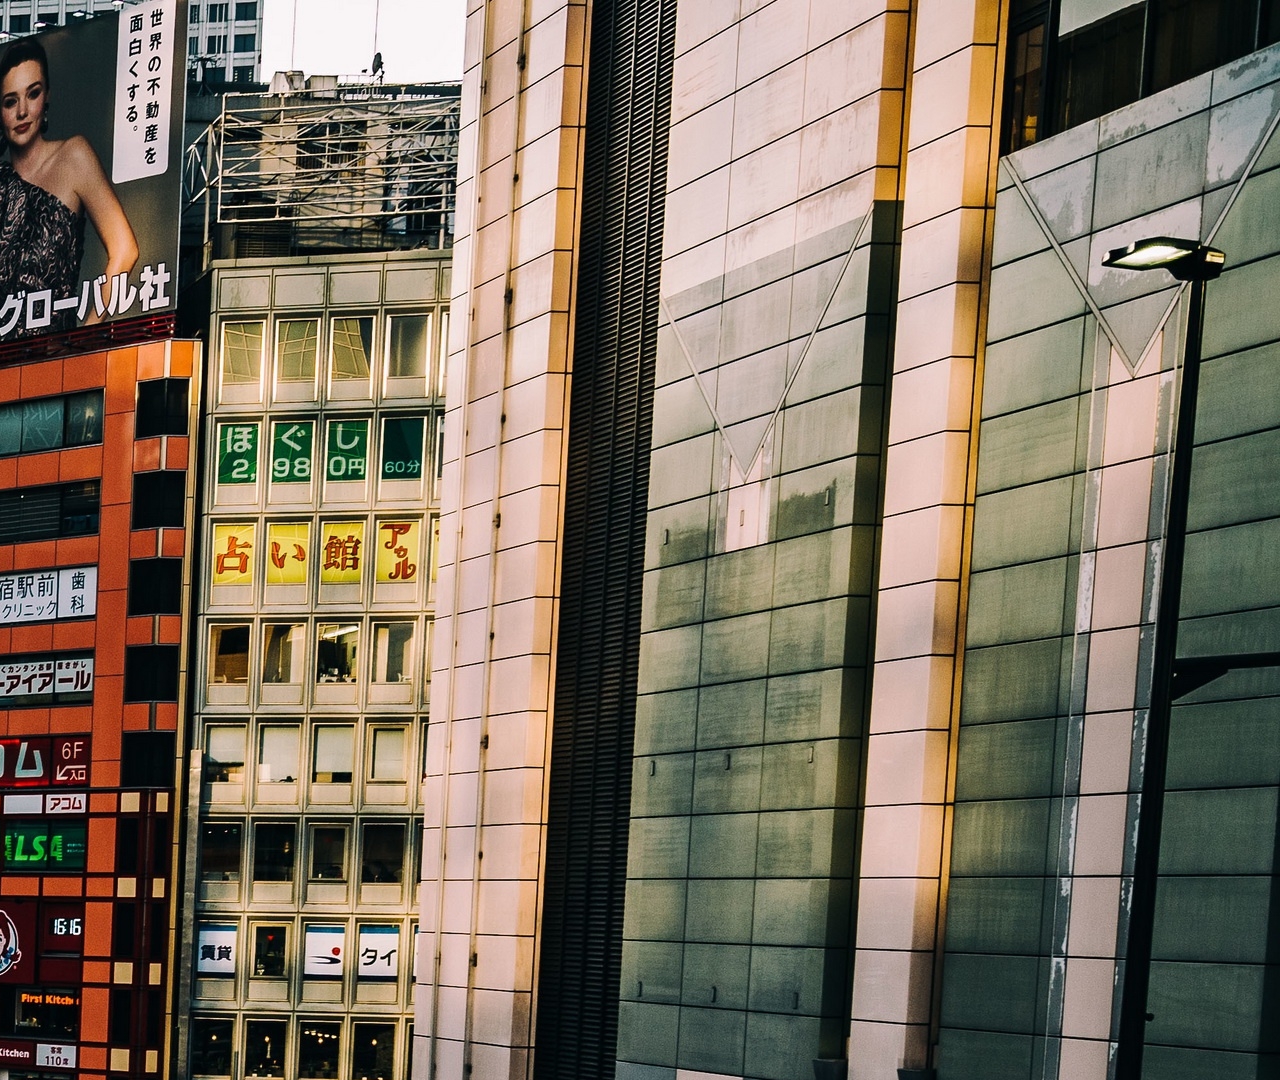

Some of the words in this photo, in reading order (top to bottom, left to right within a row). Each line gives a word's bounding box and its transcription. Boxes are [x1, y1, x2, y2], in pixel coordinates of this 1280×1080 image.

[125, 13, 144, 133] 面白くする。
[143, 8, 164, 165] 世界の不動産を
[225, 423, 360, 452] ほぐし
[231, 457, 366, 484] 2,980円
[384, 459, 421, 475] 60分
[216, 534, 363, 575] 占い館
[70, 573, 86, 614] 歯科
[61, 741, 83, 760] 6F
[69, 767, 86, 782] 入口
[50, 797, 83, 811] アコム
[53, 918, 82, 935] 16:16
[200, 944, 232, 961] 賃貸
[361, 947, 396, 966] タイ
[21, 993, 42, 1004] First
